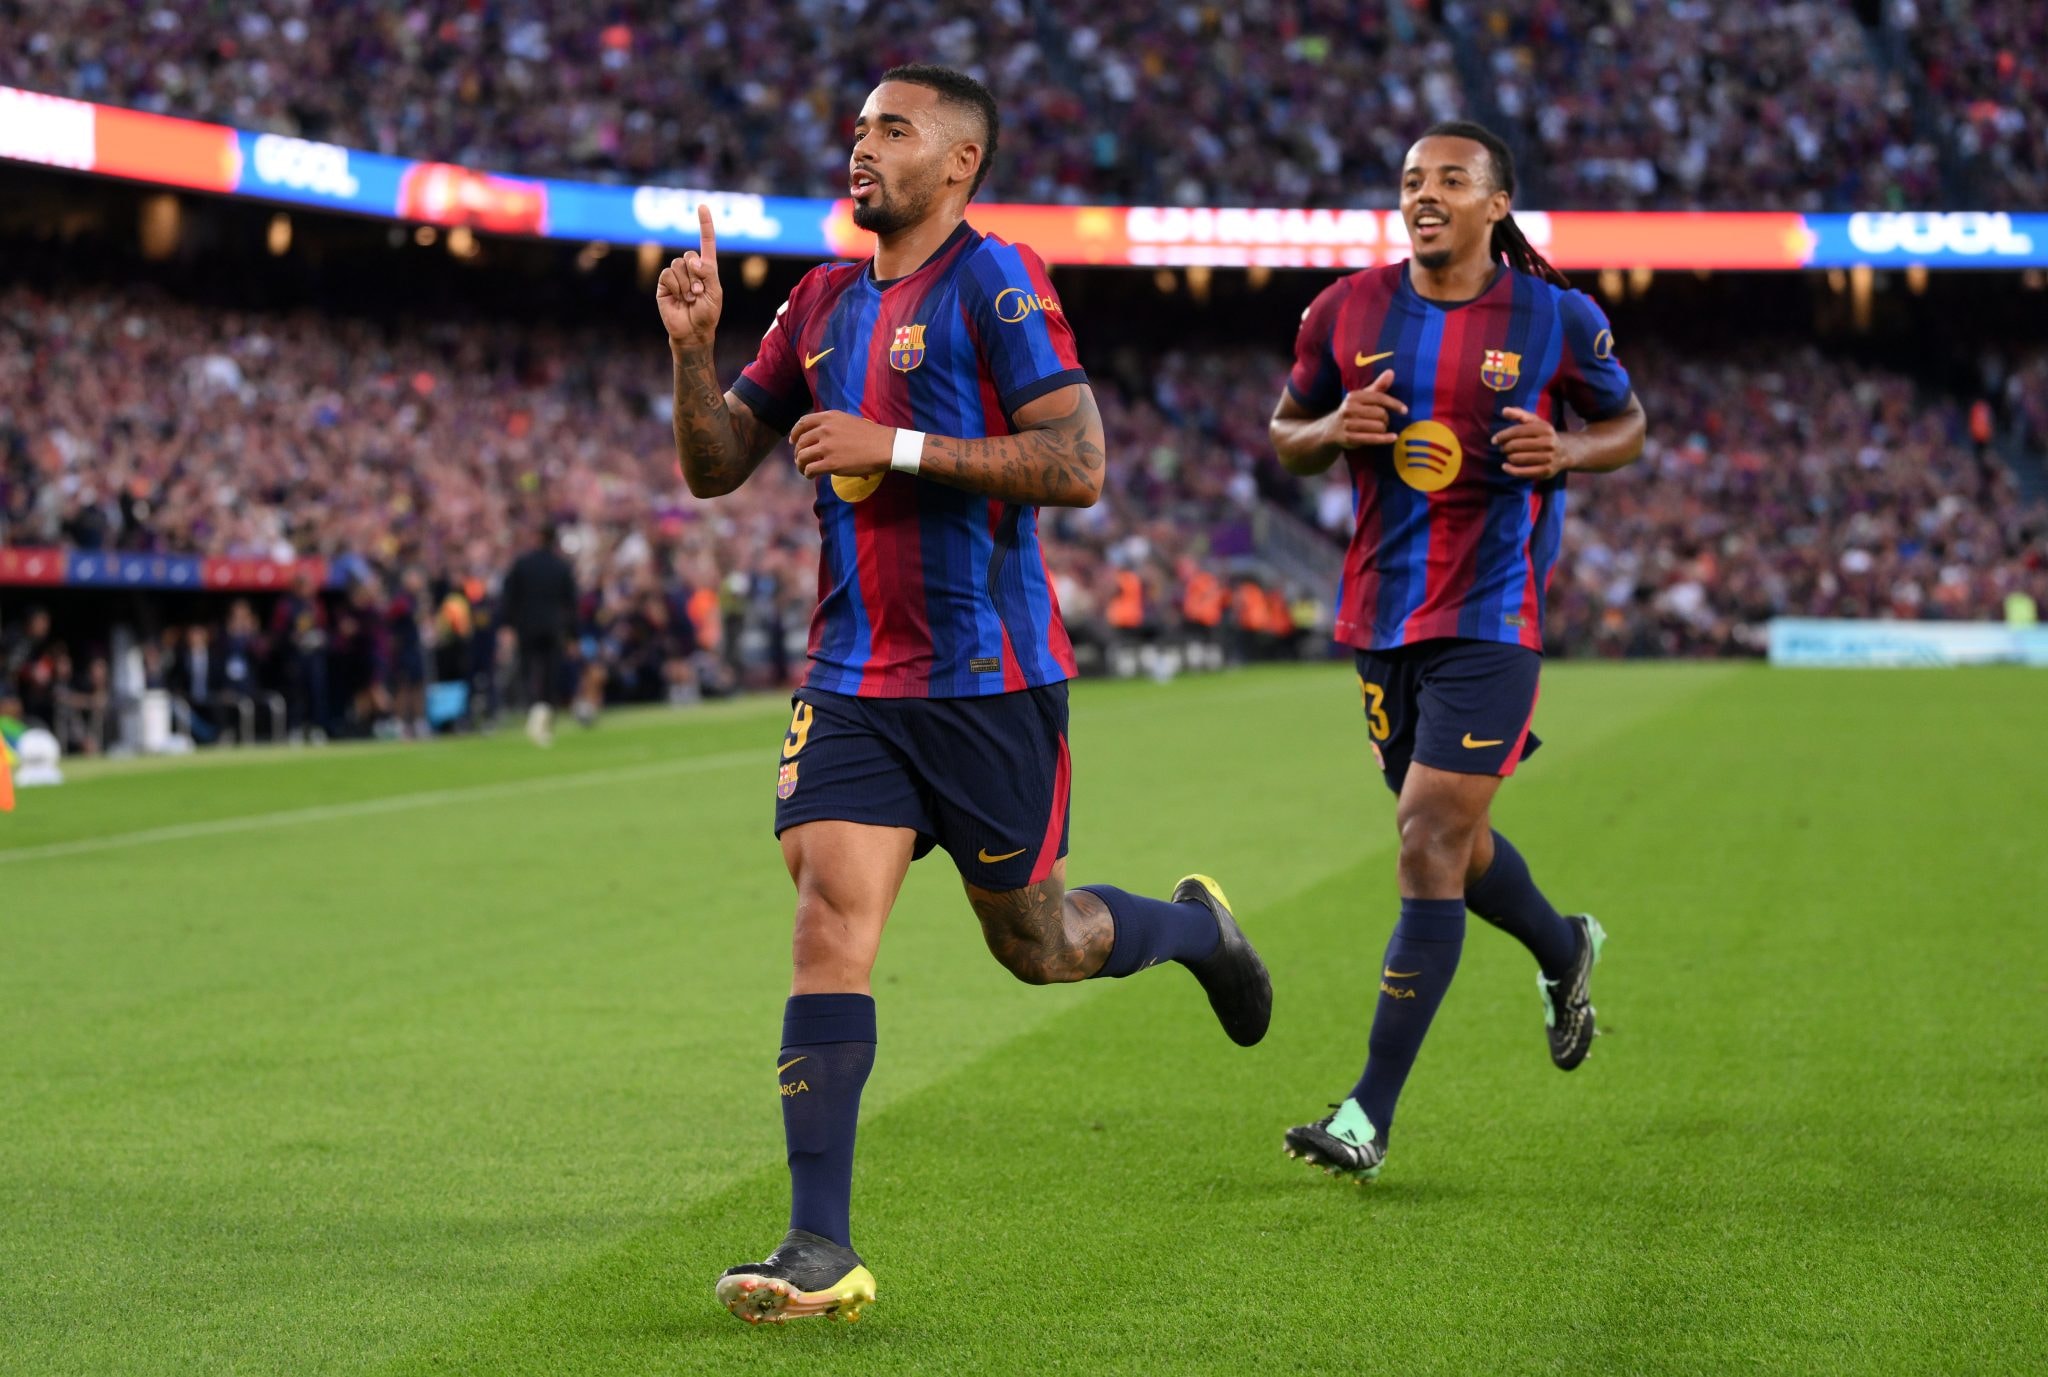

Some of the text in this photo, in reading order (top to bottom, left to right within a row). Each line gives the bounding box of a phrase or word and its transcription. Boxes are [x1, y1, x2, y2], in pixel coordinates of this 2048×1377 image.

[783, 700, 813, 758] 9
[1357, 673, 1390, 741] 3
[779, 1080, 809, 1097] ARÇA
